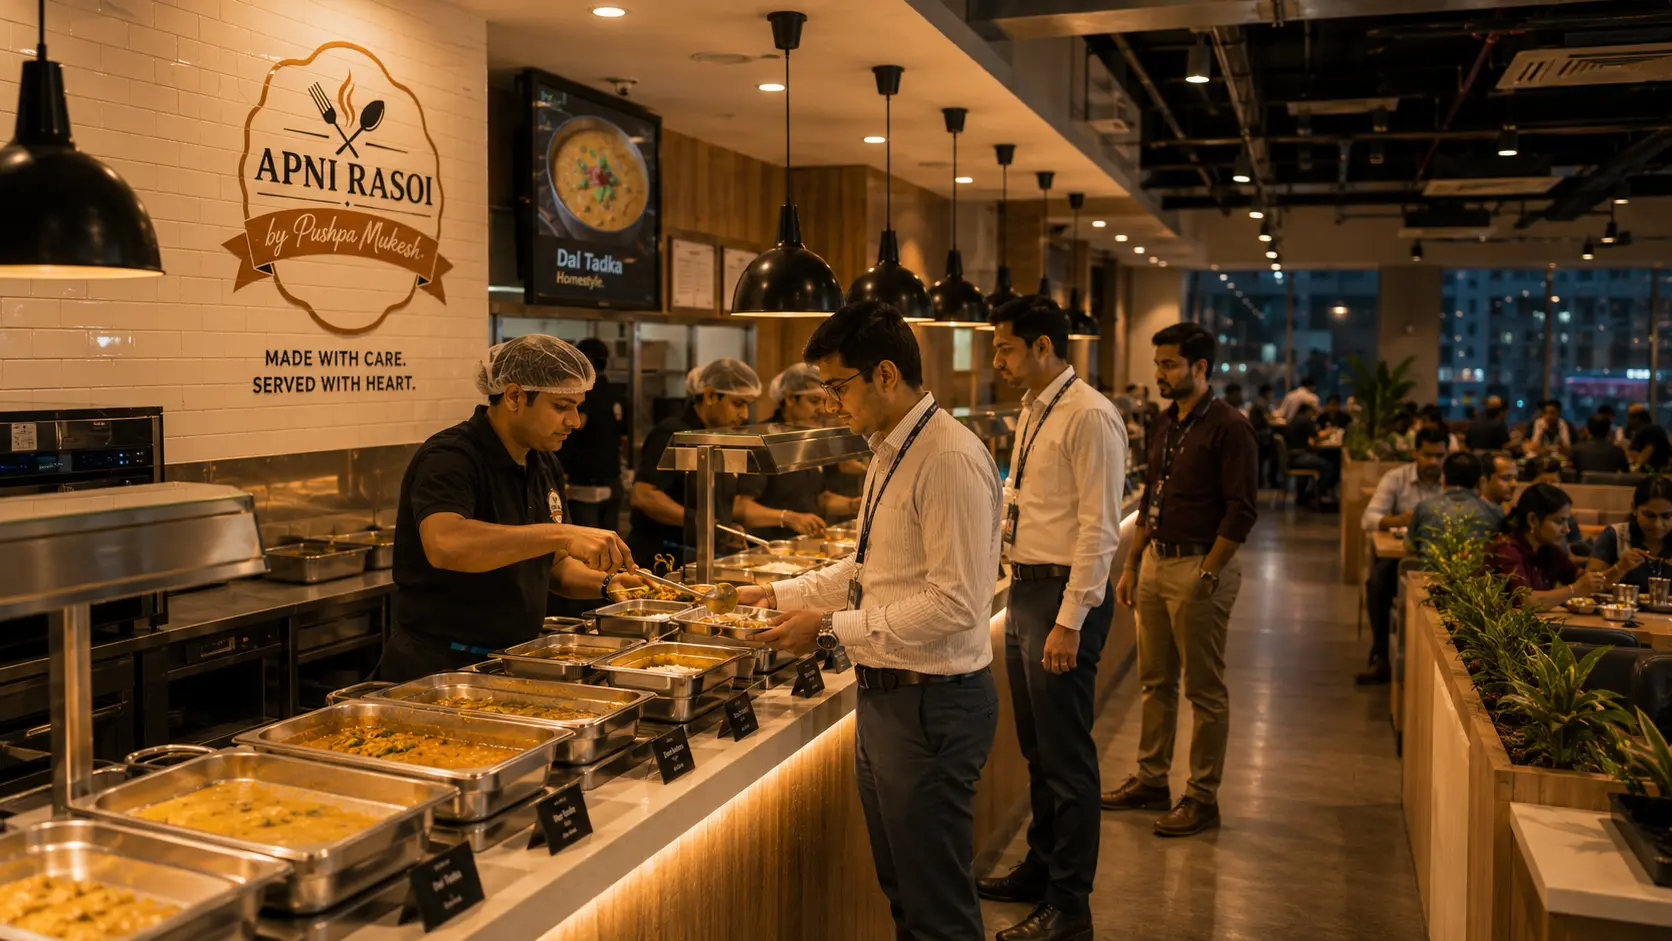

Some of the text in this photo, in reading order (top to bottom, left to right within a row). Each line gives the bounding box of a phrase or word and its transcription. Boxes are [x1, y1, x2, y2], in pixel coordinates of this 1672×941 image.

[255, 147, 433, 205] APNI RASOI
[265, 217, 289, 257] by
[293, 213, 358, 252] Pushpa
[557, 248, 623, 274] Dal Tadka
[265, 349, 407, 367] MADE WITH CARE.
[252, 375, 417, 394] SERVED WITH HEART.
